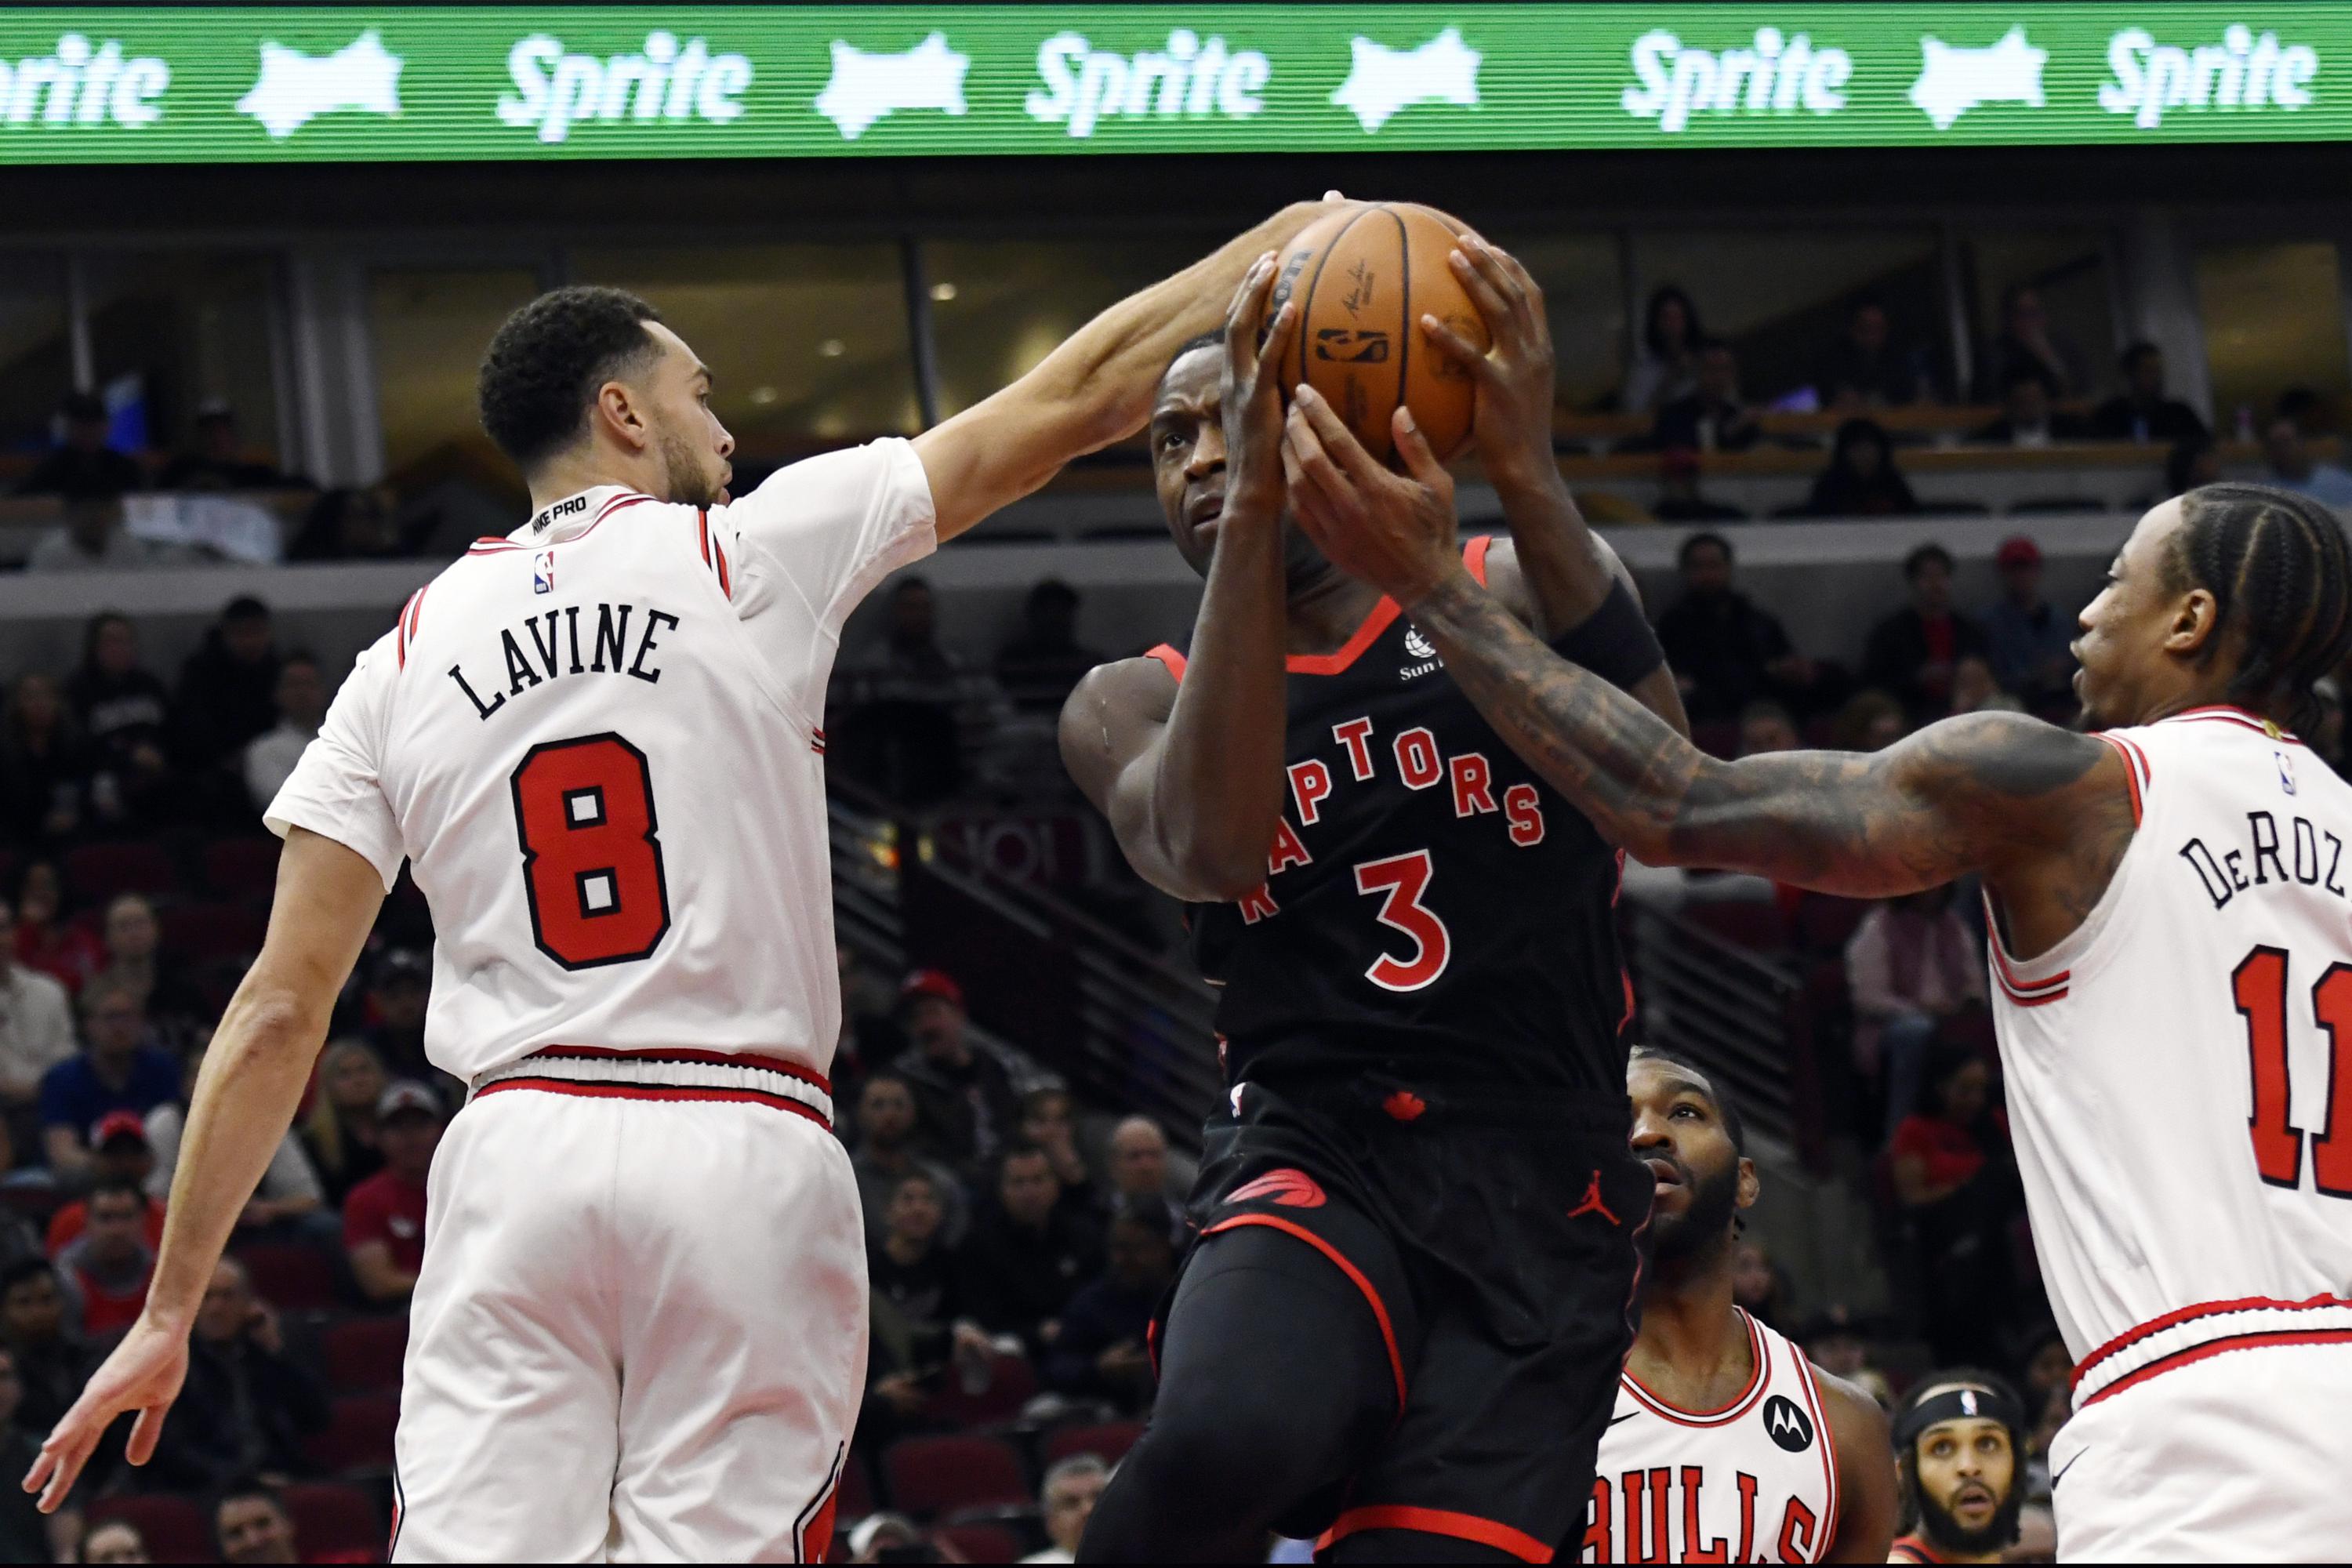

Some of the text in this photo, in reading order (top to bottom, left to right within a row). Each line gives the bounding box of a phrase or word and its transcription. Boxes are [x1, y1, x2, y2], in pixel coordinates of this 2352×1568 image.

[495, 31, 753, 143] Sprite
[1025, 29, 1271, 138] Sprite
[1621, 26, 1852, 132] Sprite
[2097, 24, 2318, 129] Sprite
[532, 496, 586, 536] NIKE PRO
[448, 603, 679, 720] LAVINE
[1399, 661, 1436, 681] Sun
[510, 731, 671, 971] 8
[1353, 848, 1450, 992] 3
[2230, 943, 2352, 1200] 11
